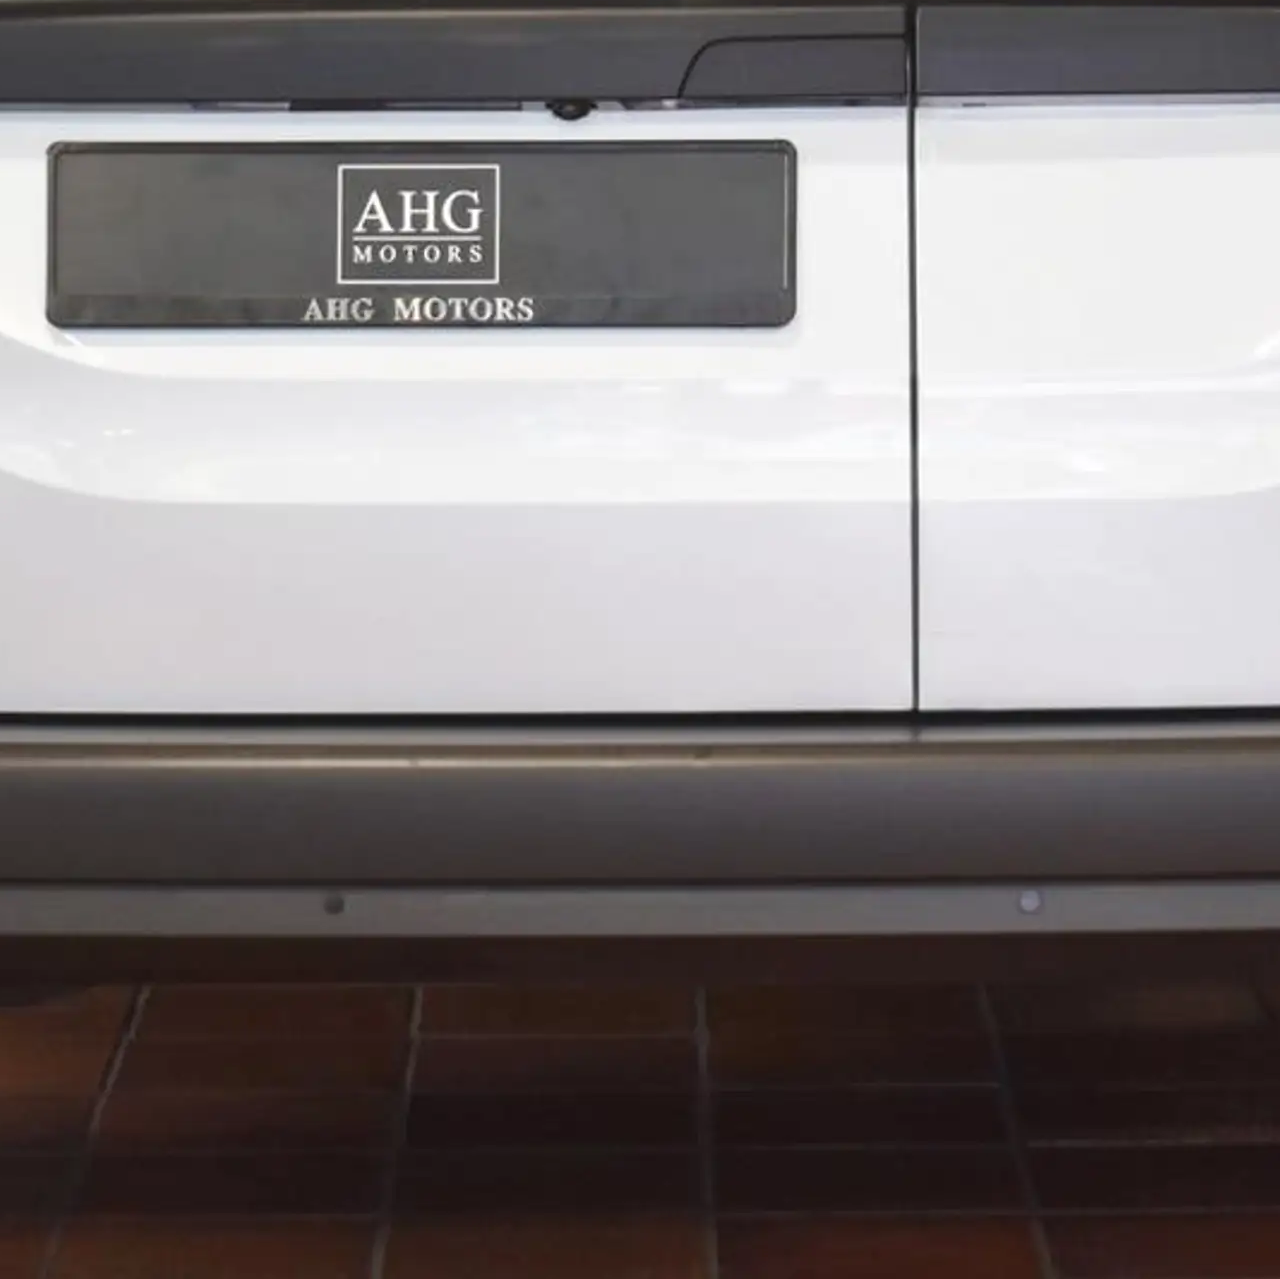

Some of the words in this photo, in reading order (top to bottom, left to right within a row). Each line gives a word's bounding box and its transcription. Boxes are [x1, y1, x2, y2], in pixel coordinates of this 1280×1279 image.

[352, 189, 484, 234] AHG
[352, 244, 483, 264] MOTORS
[302, 298, 375, 322] AHG
[392, 298, 535, 322] MOTORS
